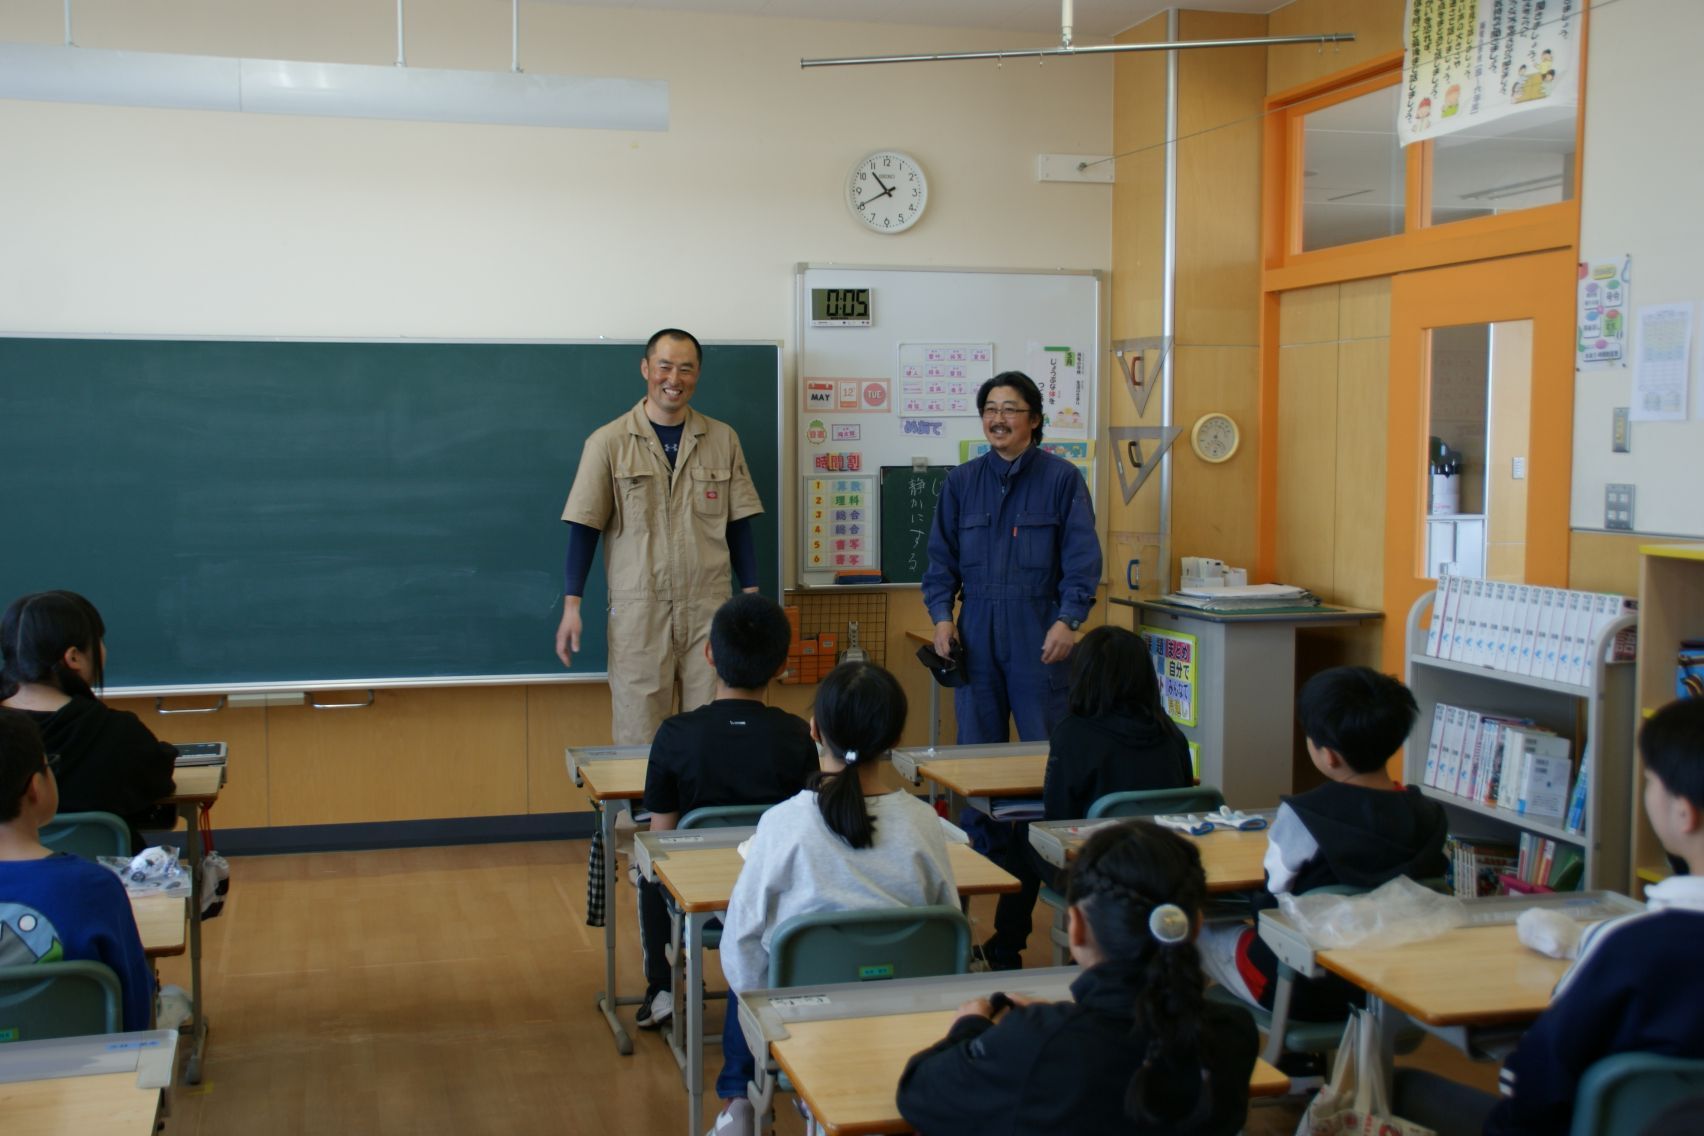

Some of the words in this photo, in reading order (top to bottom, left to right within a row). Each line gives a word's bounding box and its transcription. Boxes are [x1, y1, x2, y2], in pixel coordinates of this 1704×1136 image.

[883, 158, 891, 167] 12
[859, 172, 867, 181] 10
[908, 173, 914, 181] 2
[856, 187, 862, 195] 9
[912, 188, 918, 197] 3
[859, 202, 866, 211] 8
[908, 203, 914, 211] 4
[870, 212, 876, 221] 7
[898, 213, 904, 222] 5
[884, 217, 890, 226] 6
[826, 289, 868, 317] 0:05
[811, 393, 830, 401] MAY
[867, 390, 881, 399] TUE
[815, 455, 860, 470] 時間割
[815, 481, 820, 489] 1
[815, 496, 822, 505] 2
[836, 496, 859, 506] 理科
[836, 510, 860, 521] 総合
[908, 477, 928, 571] 静かにする
[814, 525, 821, 533] 4
[835, 524, 860, 534] 総合
[814, 541, 820, 549] 5
[814, 555, 820, 563] 6
[1168, 641, 1188, 661] まとめ
[1169, 661, 1190, 680] 自分で
